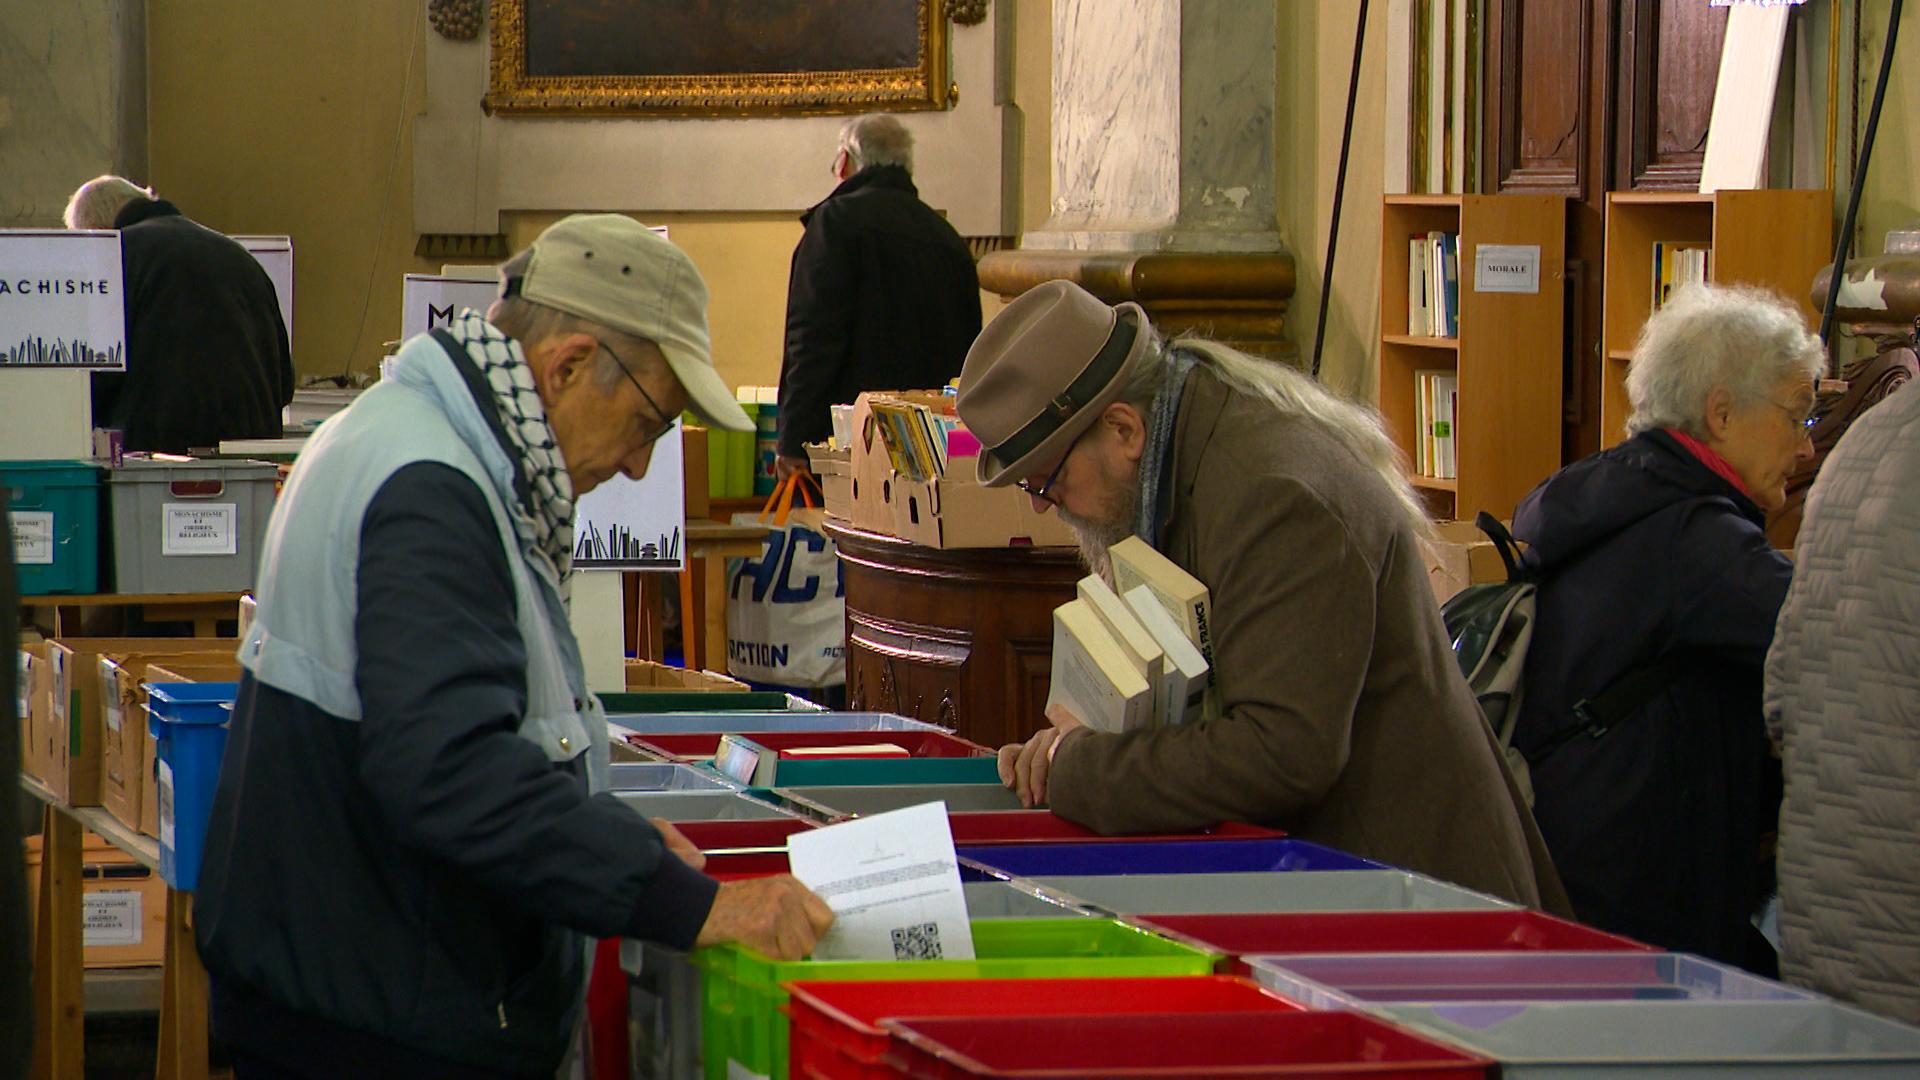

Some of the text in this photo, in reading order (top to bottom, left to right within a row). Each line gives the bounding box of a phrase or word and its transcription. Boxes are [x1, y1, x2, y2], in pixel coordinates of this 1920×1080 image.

[1487, 264, 1527, 274] MORALE
[1194, 601, 1210, 644] FRANCE
[729, 640, 788, 668] ACTION
